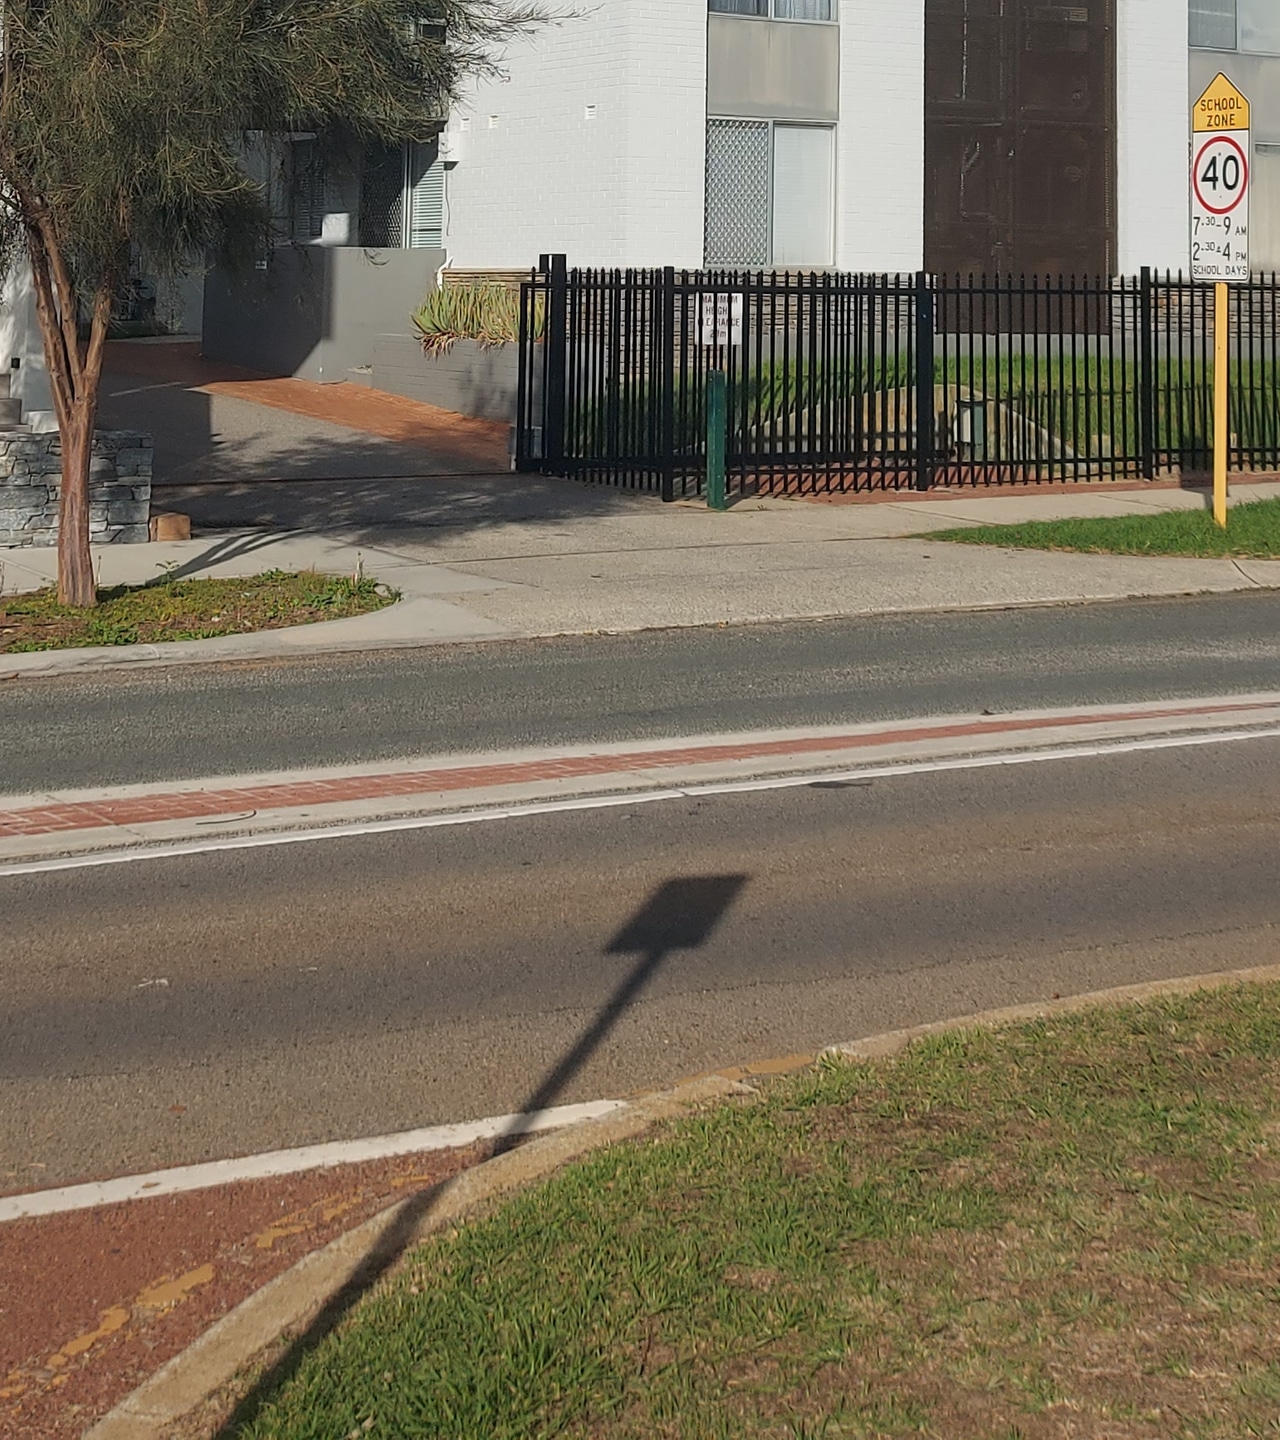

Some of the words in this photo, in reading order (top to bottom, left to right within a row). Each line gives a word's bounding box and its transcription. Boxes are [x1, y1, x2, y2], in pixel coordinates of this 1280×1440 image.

[1200, 96, 1242, 111] SCHOOL
[1207, 113, 1236, 126] ZONE
[1201, 155, 1240, 190] 40
[1235, 225, 1246, 235] AM
[1235, 251, 1246, 261] PM
[1193, 264, 1221, 275] SCHOOL
[1225, 265, 1247, 275] DAYS
